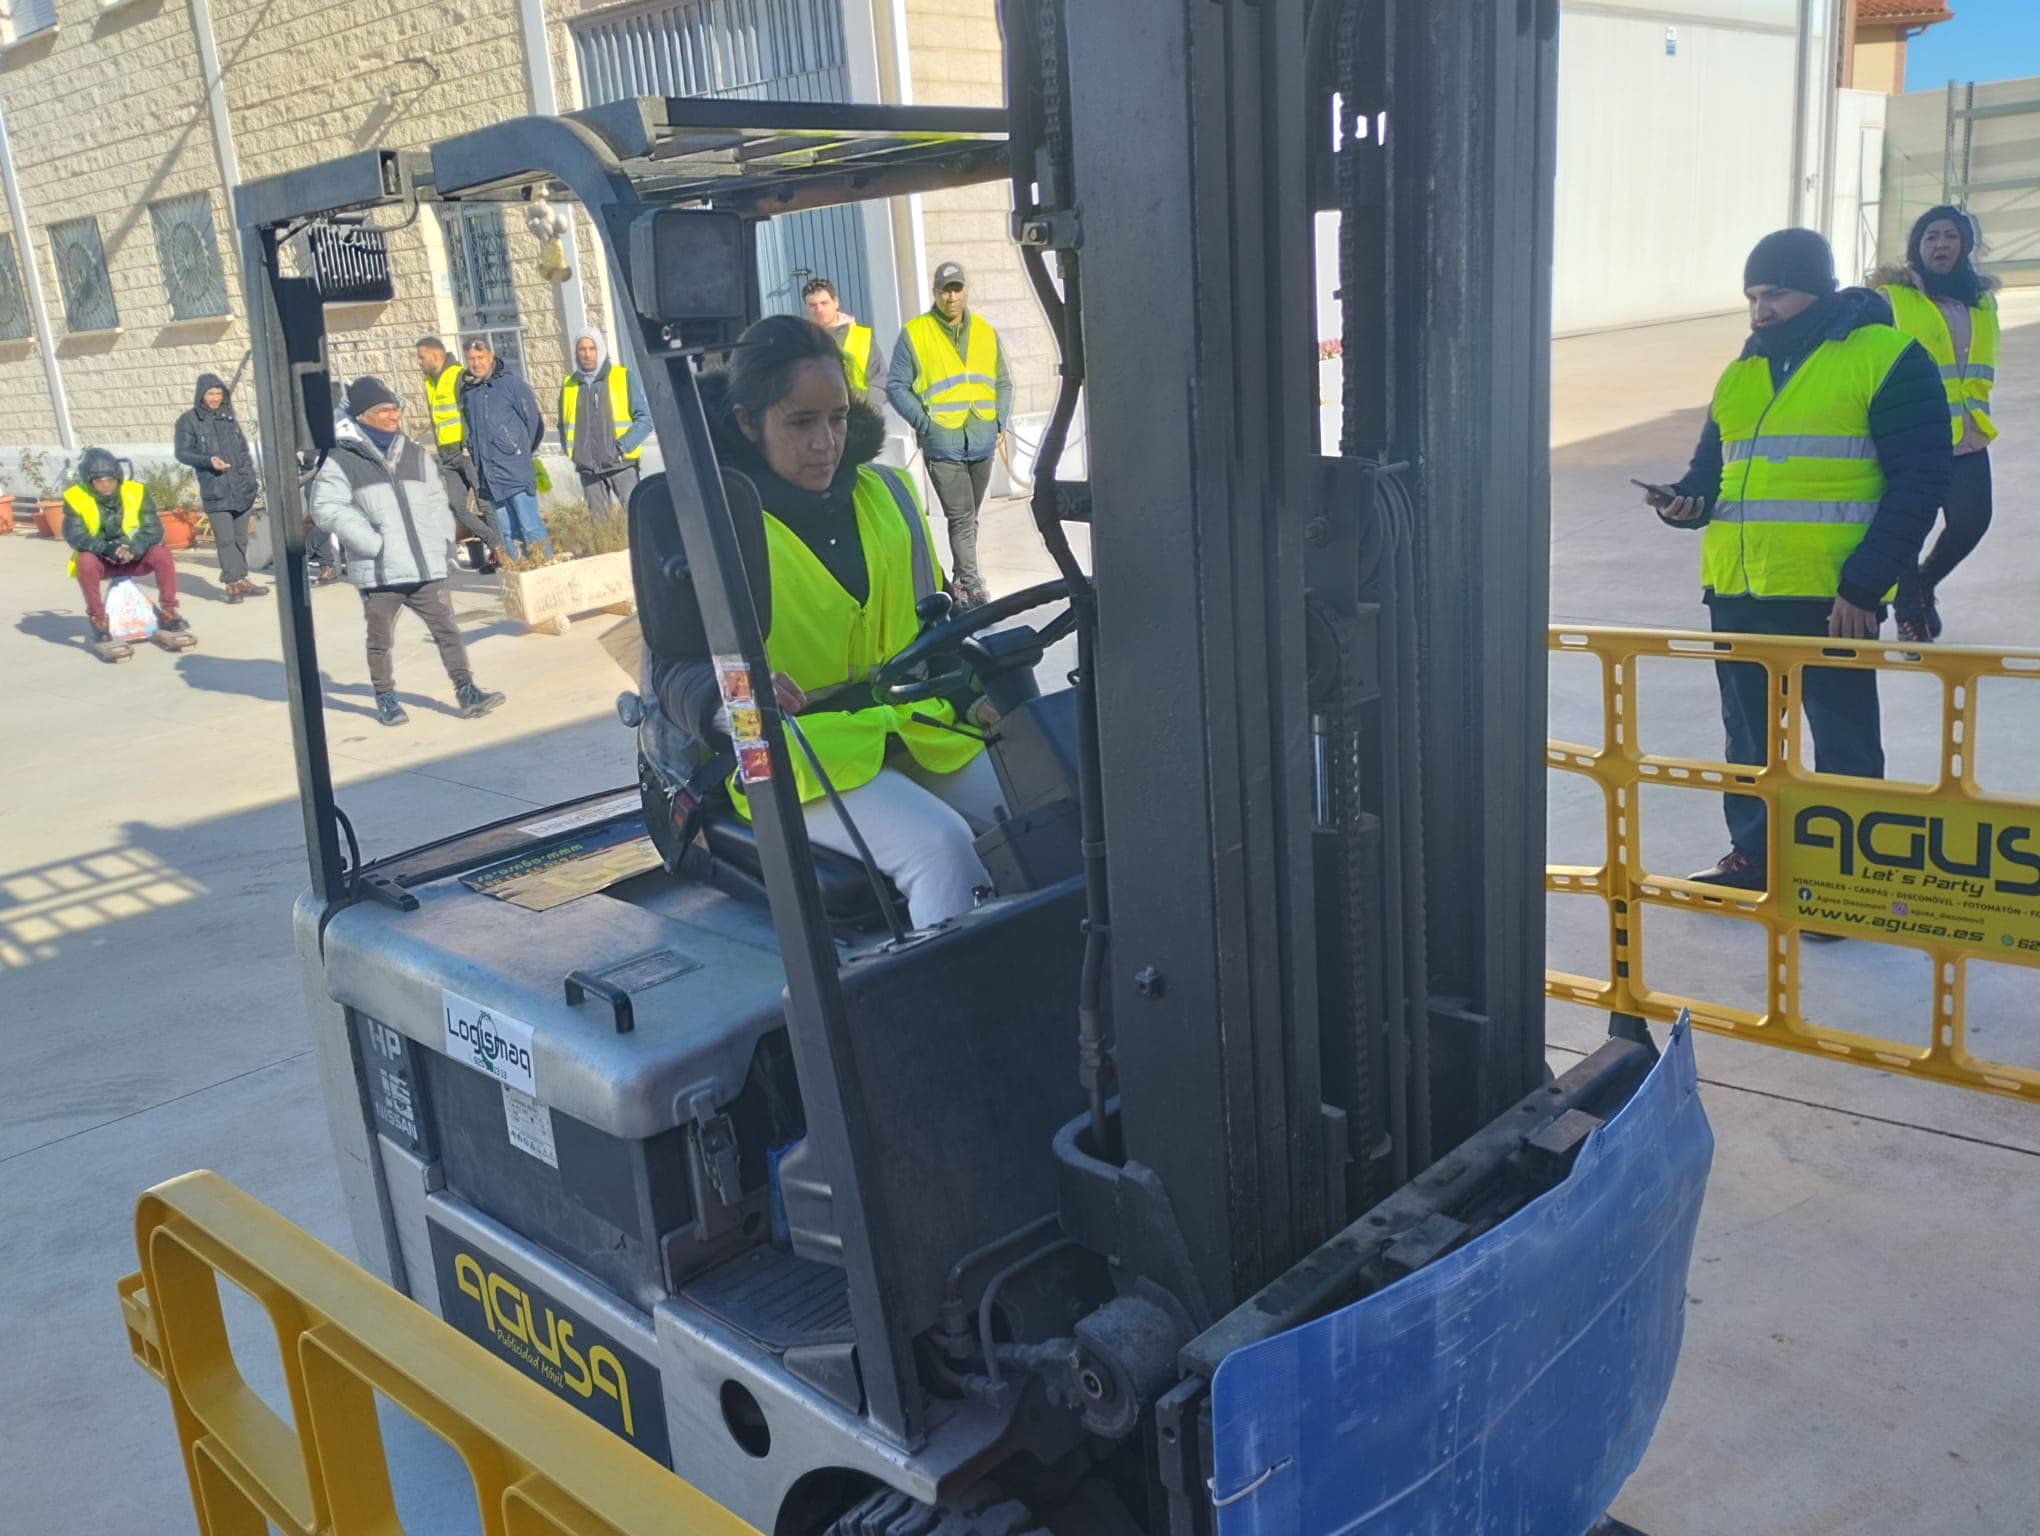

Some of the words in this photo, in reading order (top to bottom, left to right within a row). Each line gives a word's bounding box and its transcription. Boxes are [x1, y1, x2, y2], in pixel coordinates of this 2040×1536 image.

[1854, 886, 1888, 897] CARPAS
[1896, 891, 1954, 907] DISCOMÓVIL
[1963, 900, 2021, 916] FOTOMATÓN
[1922, 874, 1985, 898] Party
[1797, 904, 1985, 943] www.agusa.es
[368, 1019, 402, 1061] HP
[446, 1008, 532, 1078] Logismaq
[375, 1101, 418, 1141] NISSAN
[454, 1252, 634, 1437] AGUSA
[496, 1328, 540, 1371] Publicidad
[541, 1360, 565, 1389] Móvil
